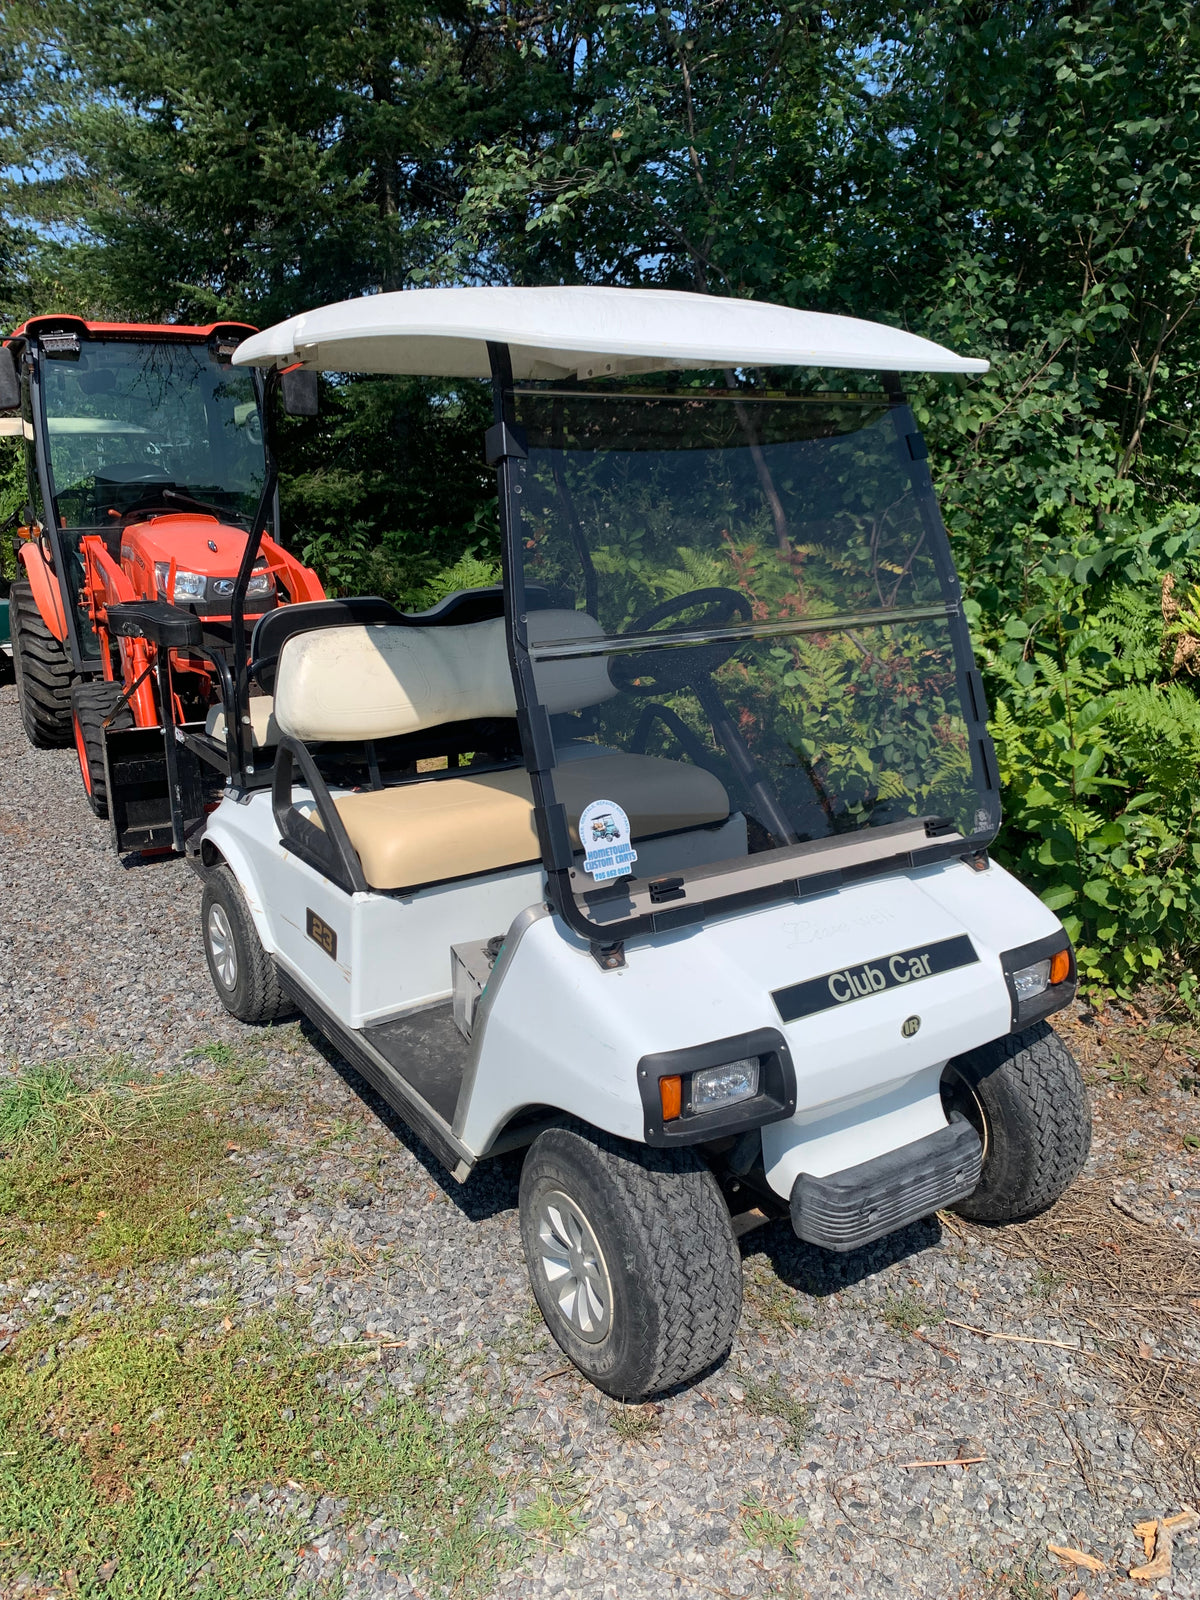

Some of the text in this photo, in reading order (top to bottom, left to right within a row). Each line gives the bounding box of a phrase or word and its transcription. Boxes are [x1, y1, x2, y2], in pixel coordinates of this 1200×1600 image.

[585, 851, 637, 871] CUSTOM CARTS
[588, 843, 630, 860] HOMETOWN
[312, 917, 333, 952] 23
[827, 953, 932, 1002] Club Car
[903, 1018, 919, 1035] IR
